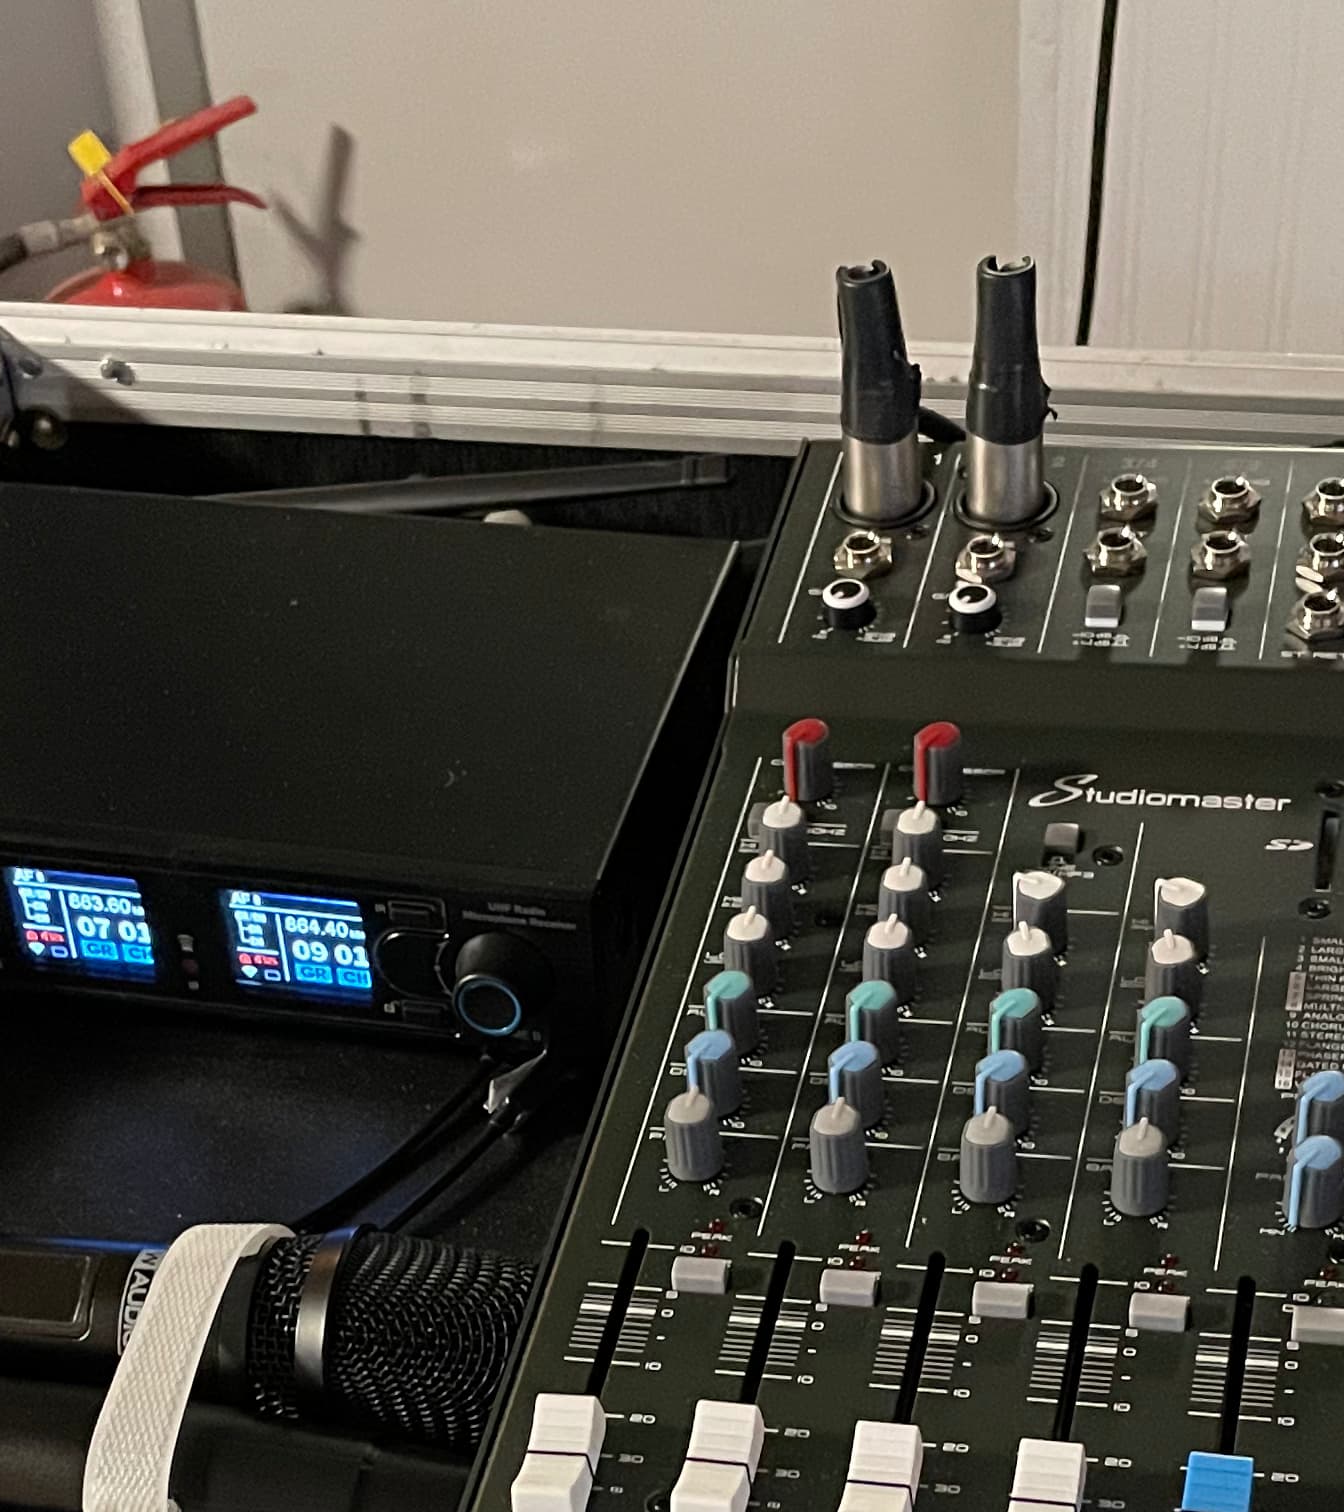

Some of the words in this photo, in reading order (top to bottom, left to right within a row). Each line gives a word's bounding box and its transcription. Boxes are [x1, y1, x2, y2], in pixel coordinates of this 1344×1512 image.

[1028, 774, 1292, 811] Studiomaster
[76, 915, 111, 940] 07
[117, 919, 152, 945] 01
[86, 942, 116, 956] GR
[291, 939, 328, 963] 09
[333, 943, 370, 969] 01
[299, 966, 329, 980] GR
[1285, 1020, 1299, 1029] 10
[690, 1230, 734, 1243] PEAK
[837, 1243, 881, 1254] PEAK
[988, 1254, 1033, 1266] PEAK
[1142, 1267, 1188, 1278] PEAK
[660, 1307, 675, 1319] 0
[810, 1320, 825, 1332] 0
[964, 1333, 979, 1345] 0
[1122, 1346, 1137, 1357] 0
[644, 1361, 662, 1372] 10
[1283, 1359, 1299, 1371] 0
[796, 1374, 815, 1385] 10
[953, 1388, 971, 1399] 10
[1113, 1402, 1131, 1413] 10
[1277, 1416, 1296, 1427] 10
